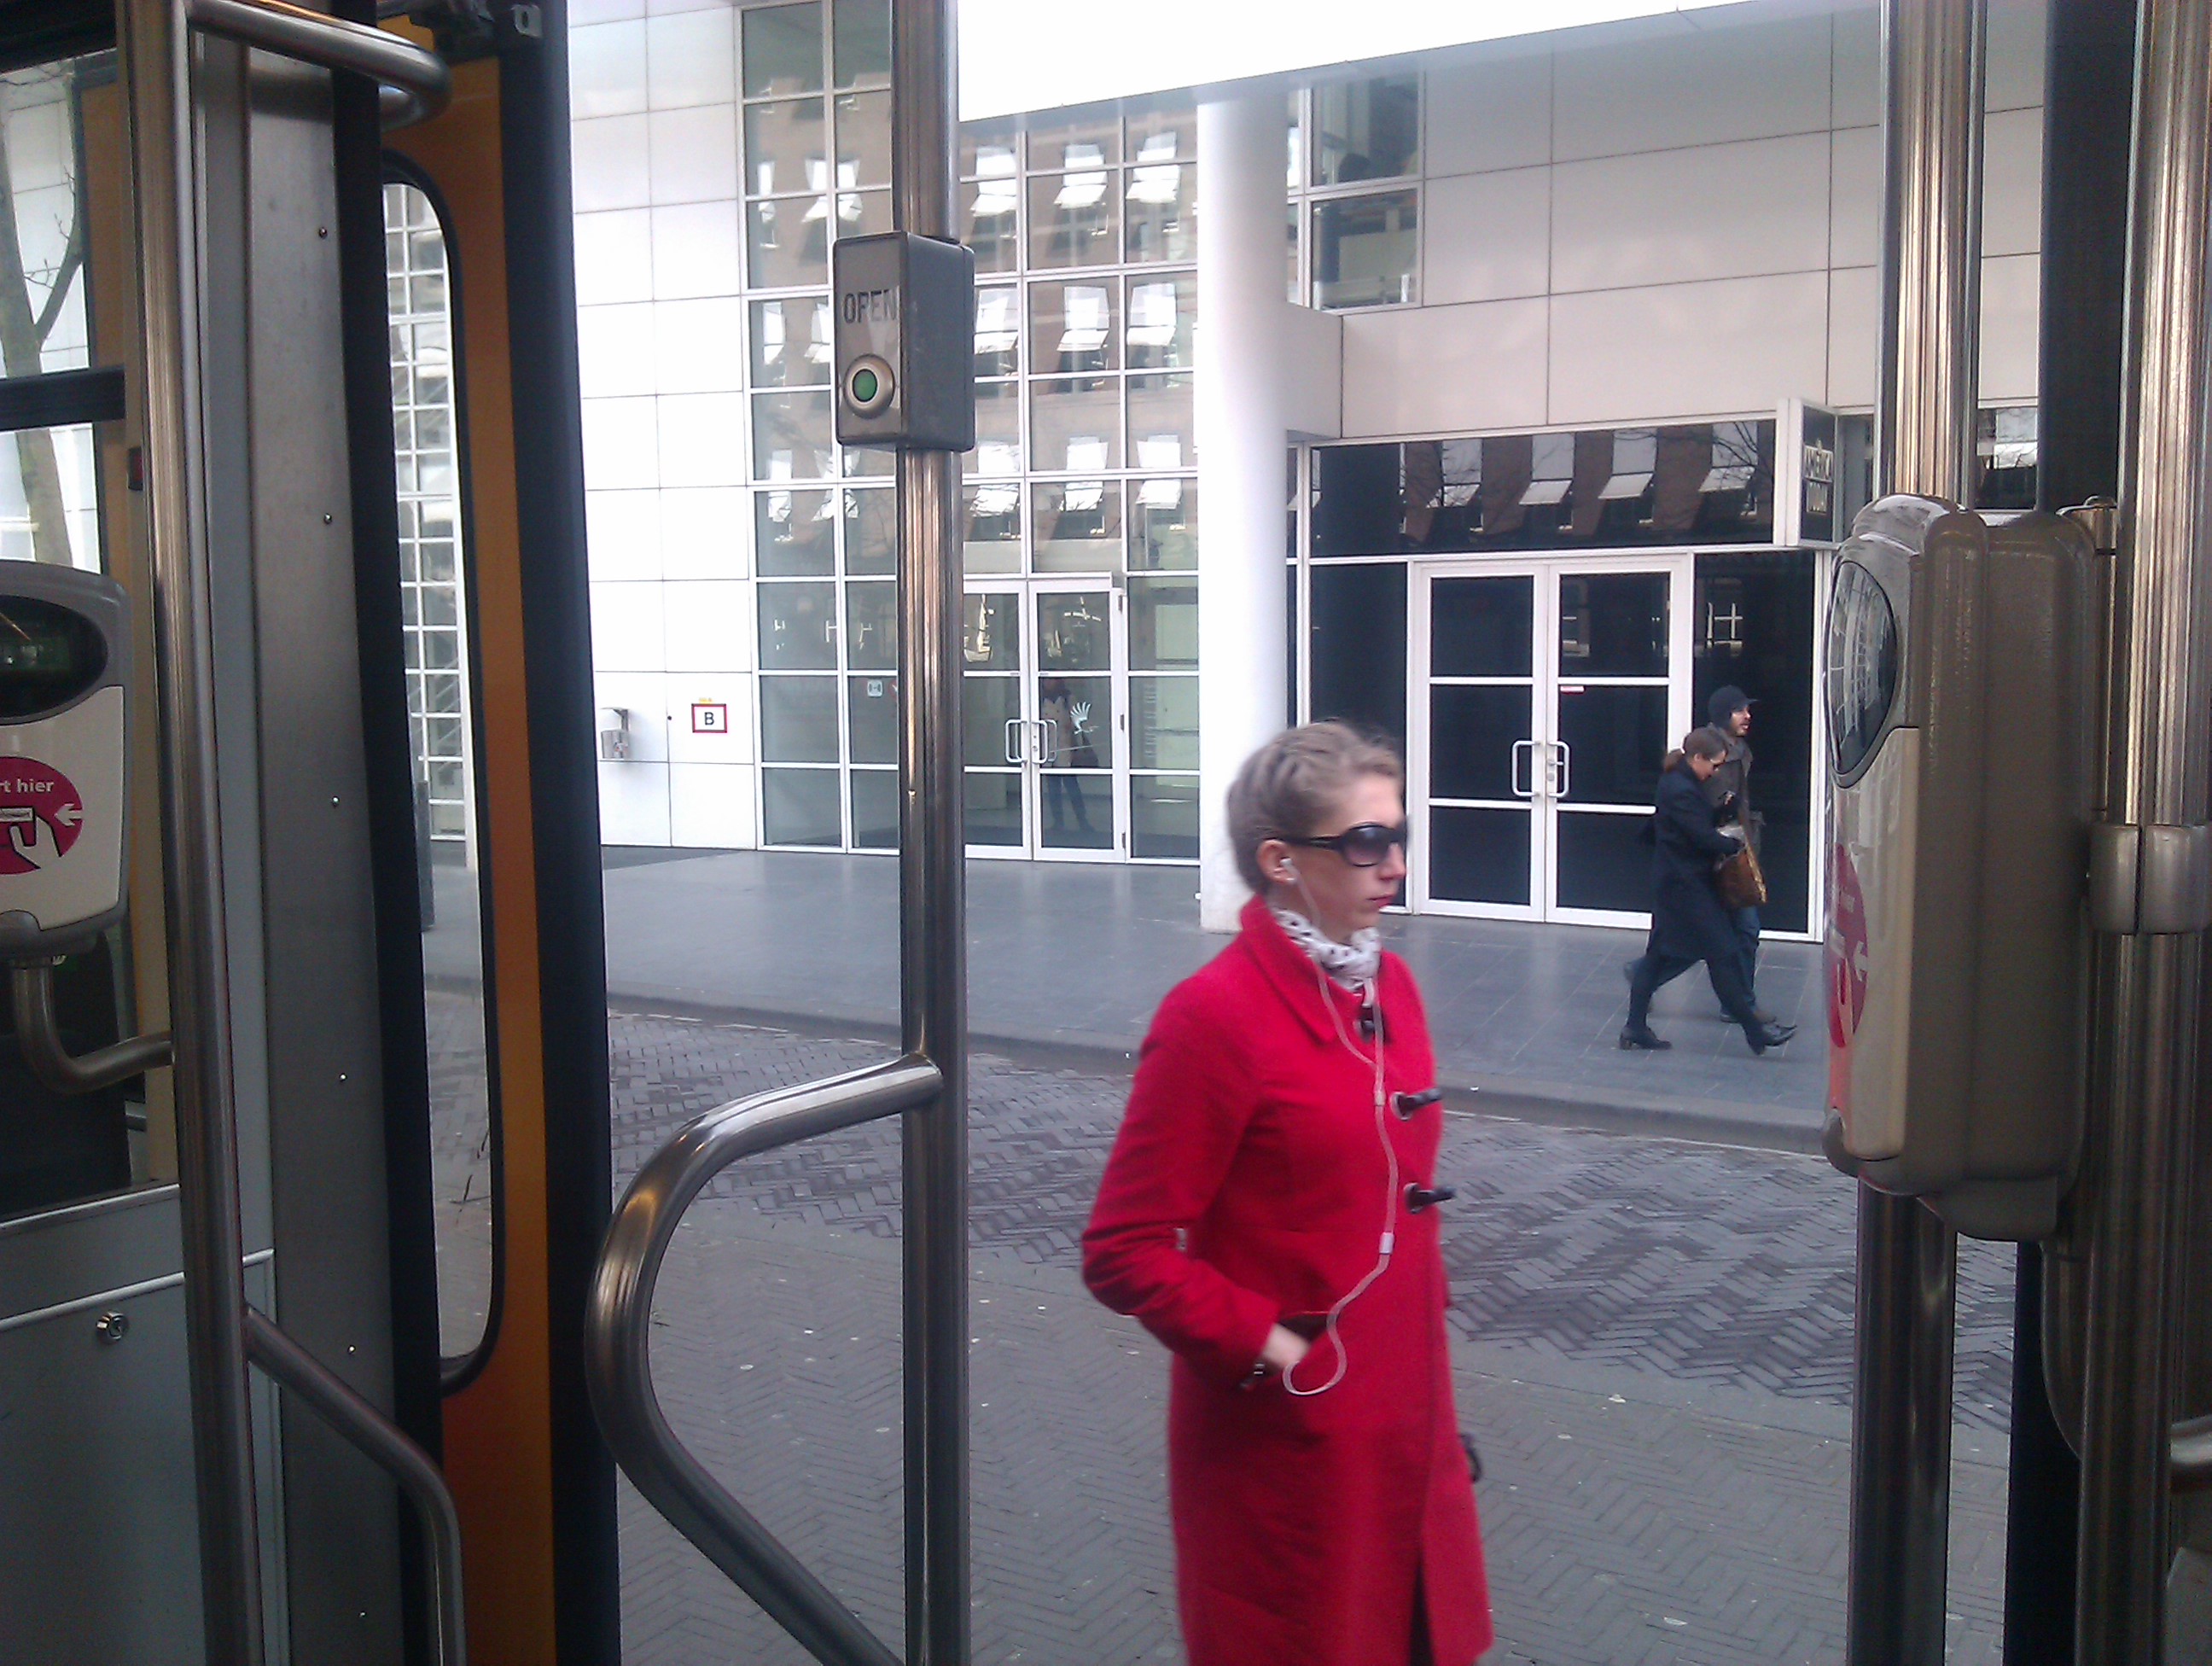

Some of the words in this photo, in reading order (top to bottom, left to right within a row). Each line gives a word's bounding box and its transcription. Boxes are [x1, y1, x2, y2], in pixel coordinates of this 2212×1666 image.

[842, 288, 897, 323] OPEN
[704, 711, 715, 725] B
[17, 778, 55, 794] hier
